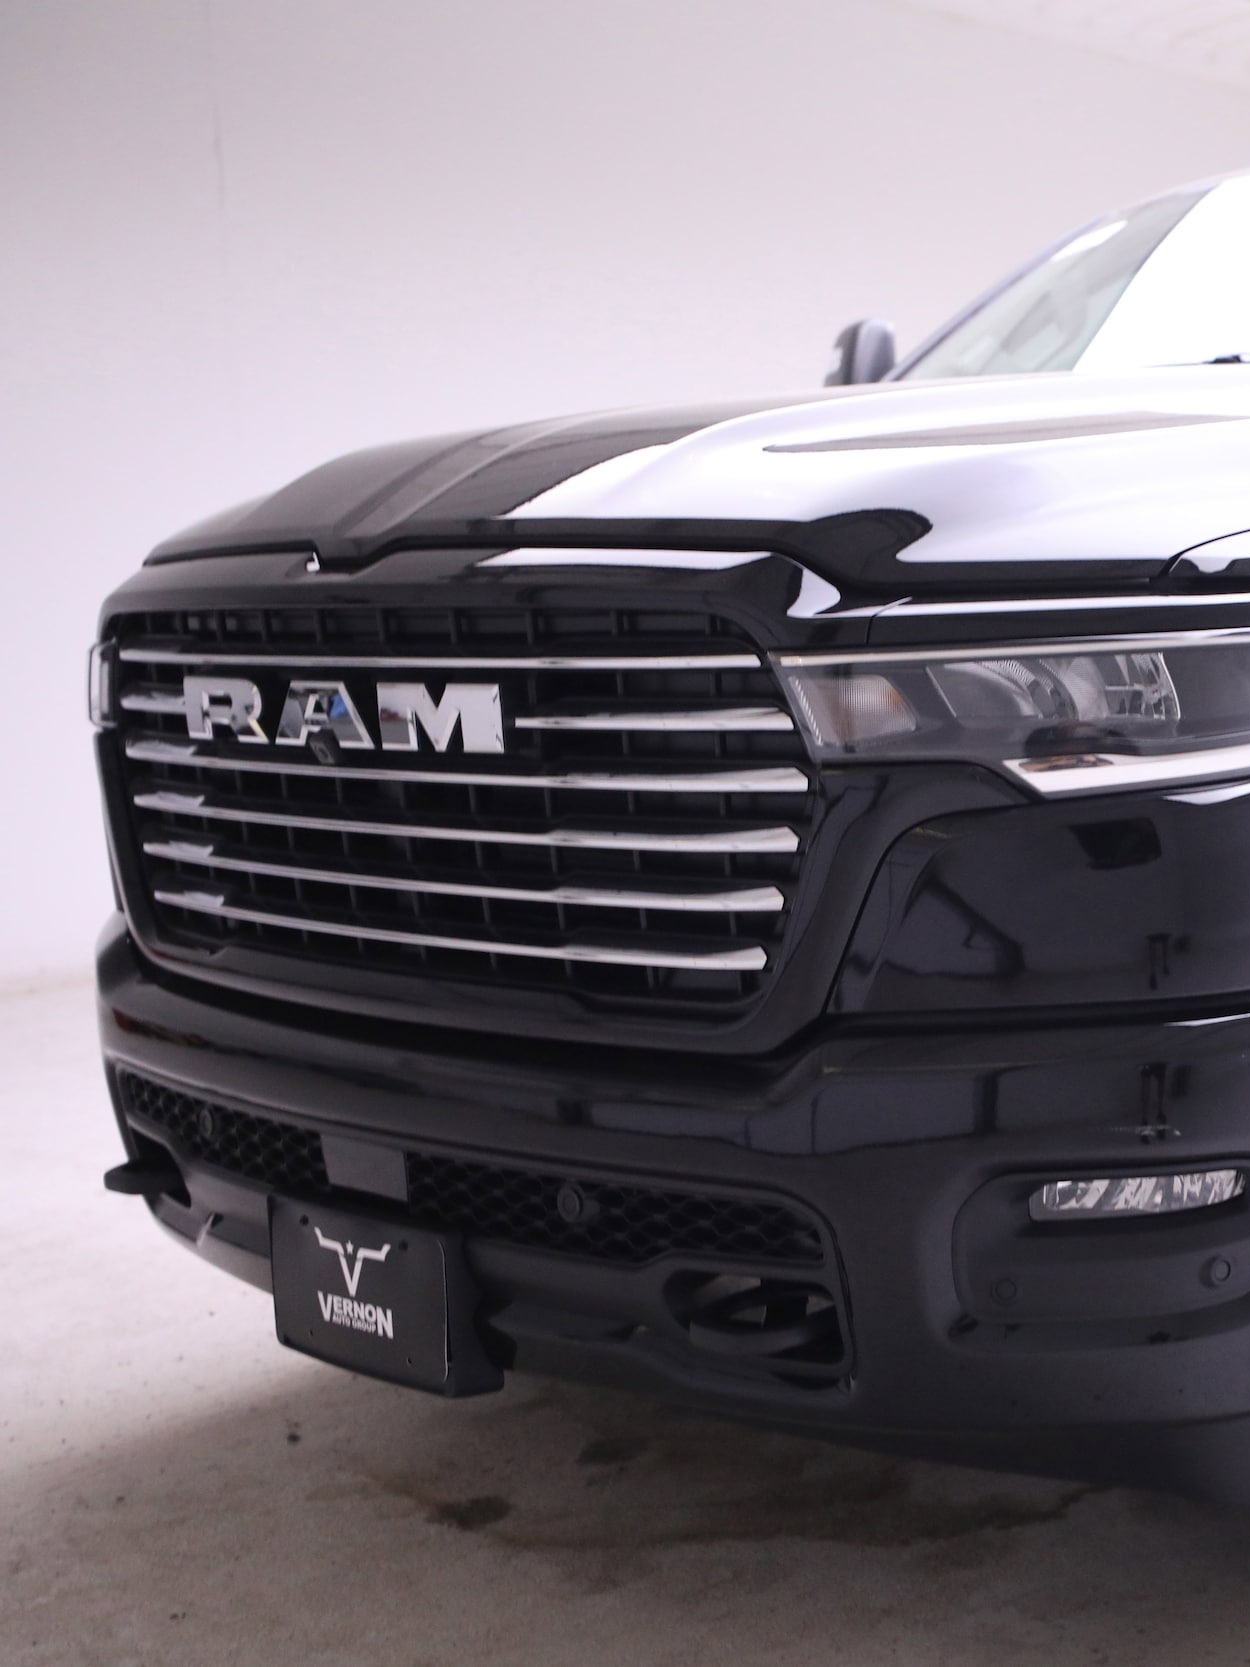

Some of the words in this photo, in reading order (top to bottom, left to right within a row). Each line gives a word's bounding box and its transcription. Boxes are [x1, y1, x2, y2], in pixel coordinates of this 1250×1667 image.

[183, 676, 504, 753] RAM
[317, 1290, 394, 1339] VERNON
[332, 1312, 351, 1328] AUTO
[352, 1317, 377, 1334] GROUP
